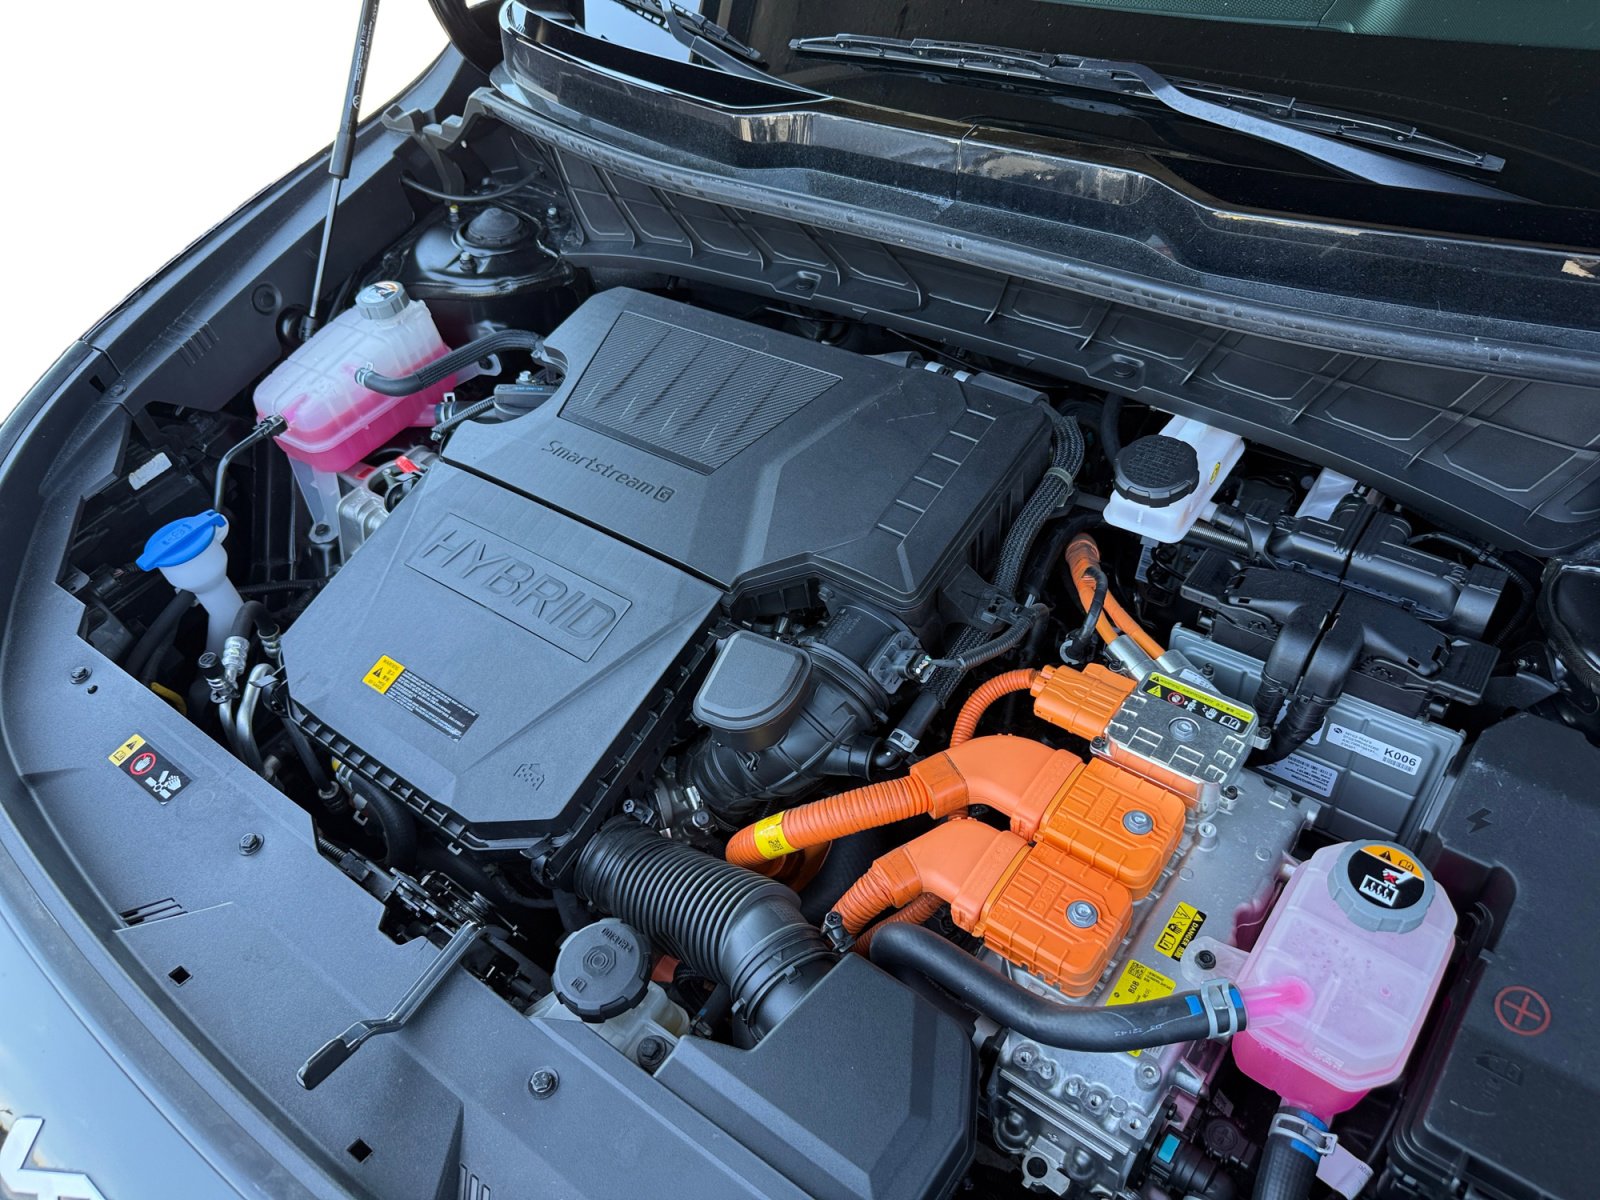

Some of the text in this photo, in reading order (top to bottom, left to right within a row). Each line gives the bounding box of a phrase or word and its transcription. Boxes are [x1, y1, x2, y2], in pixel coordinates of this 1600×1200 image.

[542, 440, 657, 495] Smartstream
[422, 529, 617, 641] HYBRID
[1384, 747, 1417, 767] K006
[1033, 877, 1060, 912] HSG
[1181, 921, 1199, 946] DANGER
